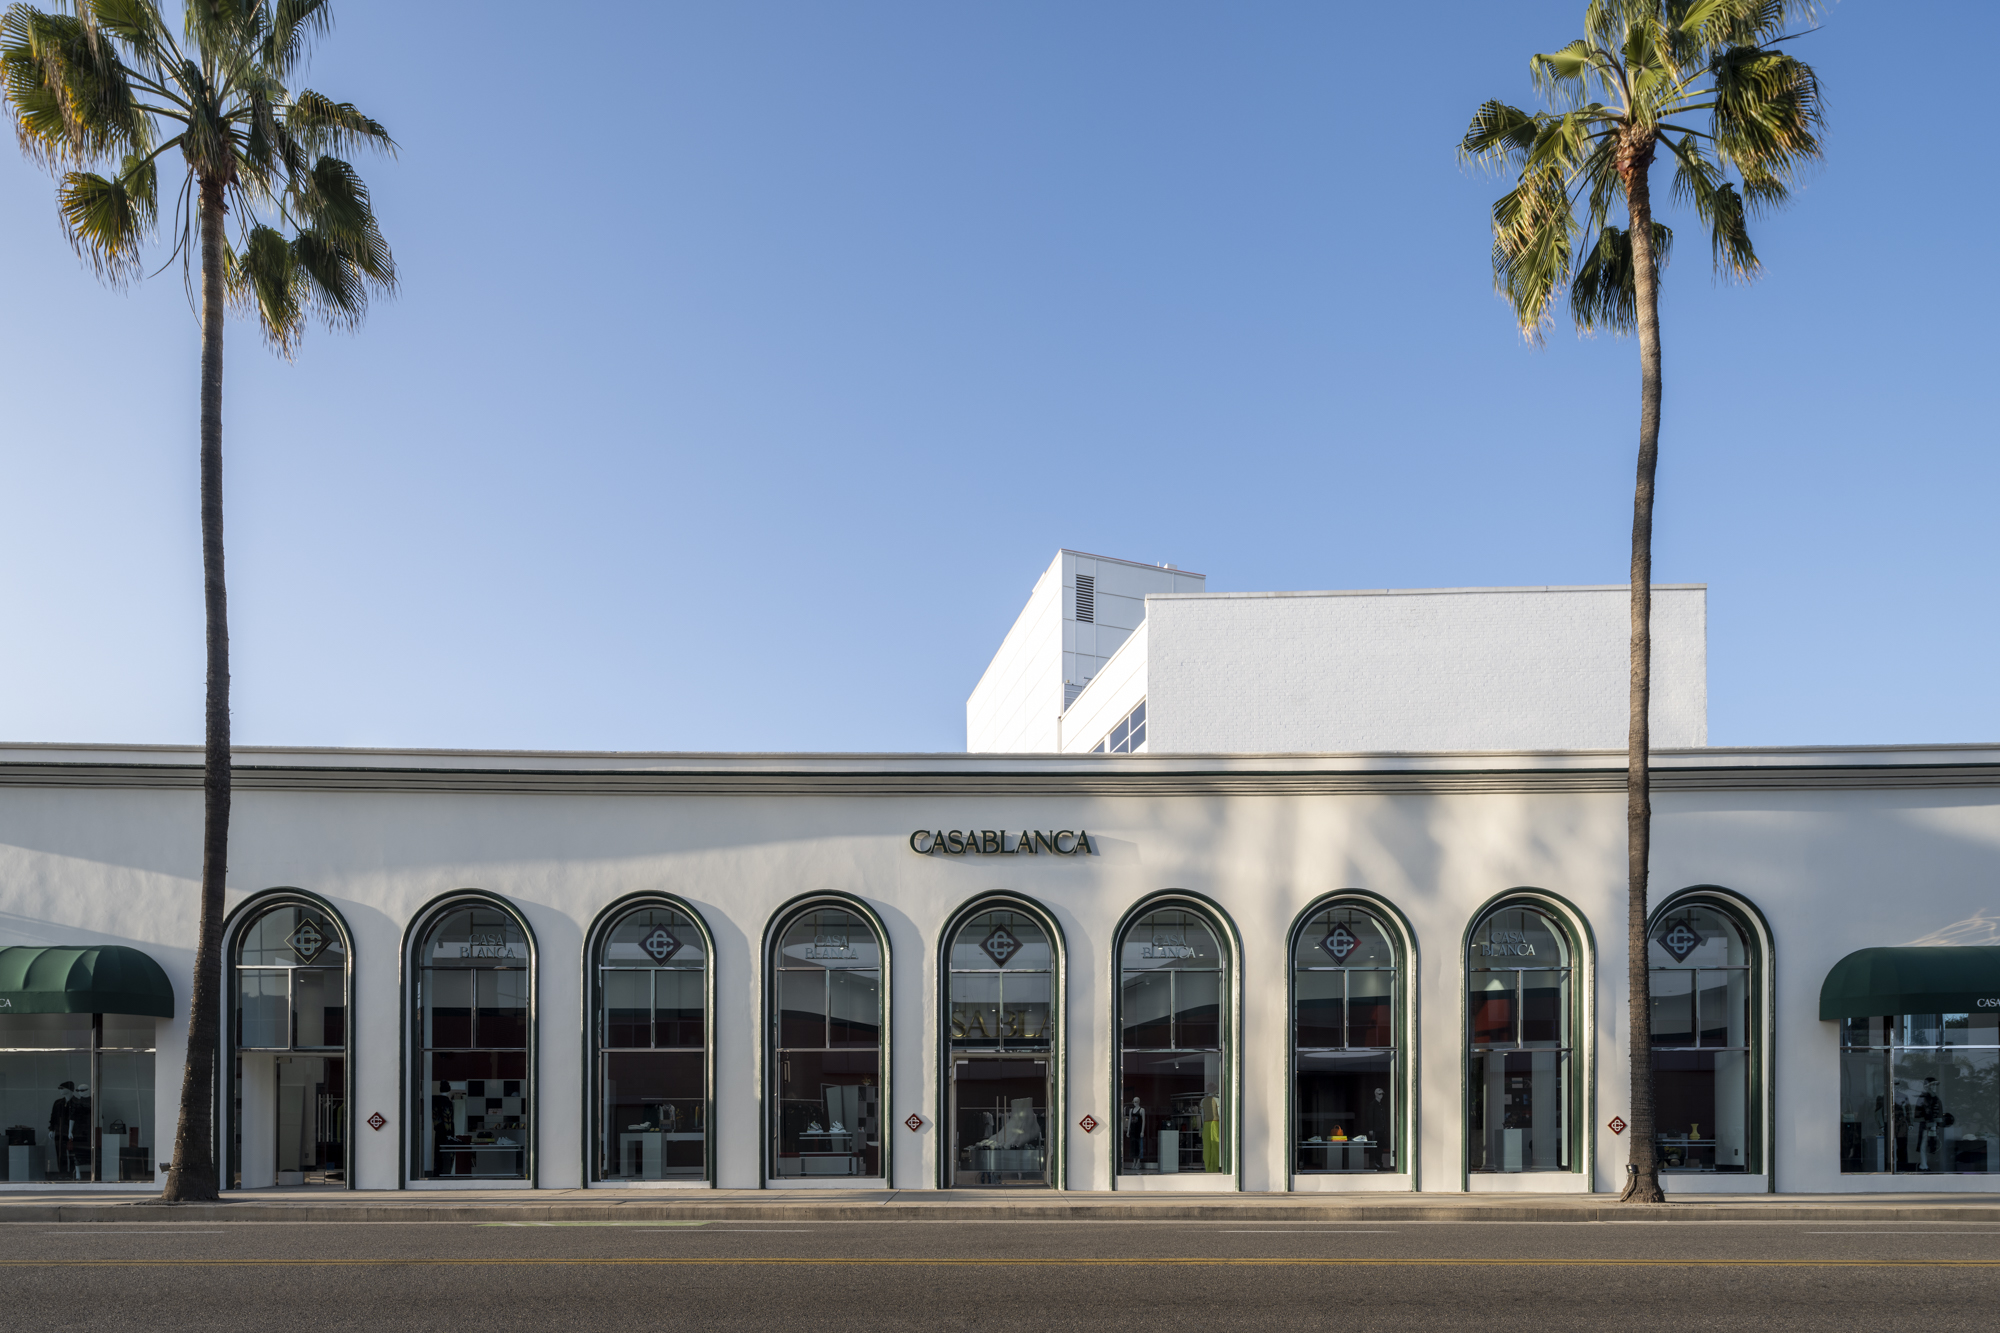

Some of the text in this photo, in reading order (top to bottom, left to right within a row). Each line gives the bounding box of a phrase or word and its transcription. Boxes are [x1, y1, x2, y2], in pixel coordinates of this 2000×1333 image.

[910, 830, 1092, 854] CASABLANCA
[469, 933, 504, 946] CASA
[814, 934, 848, 946] CASA
[1152, 934, 1187, 946] CASA
[1491, 931, 1526, 944] CASA
[460, 946, 515, 958] BLANCA
[805, 947, 859, 959] BLANCA
[1142, 946, 1196, 959] BLANCA
[1481, 944, 1536, 956] BLANCA
